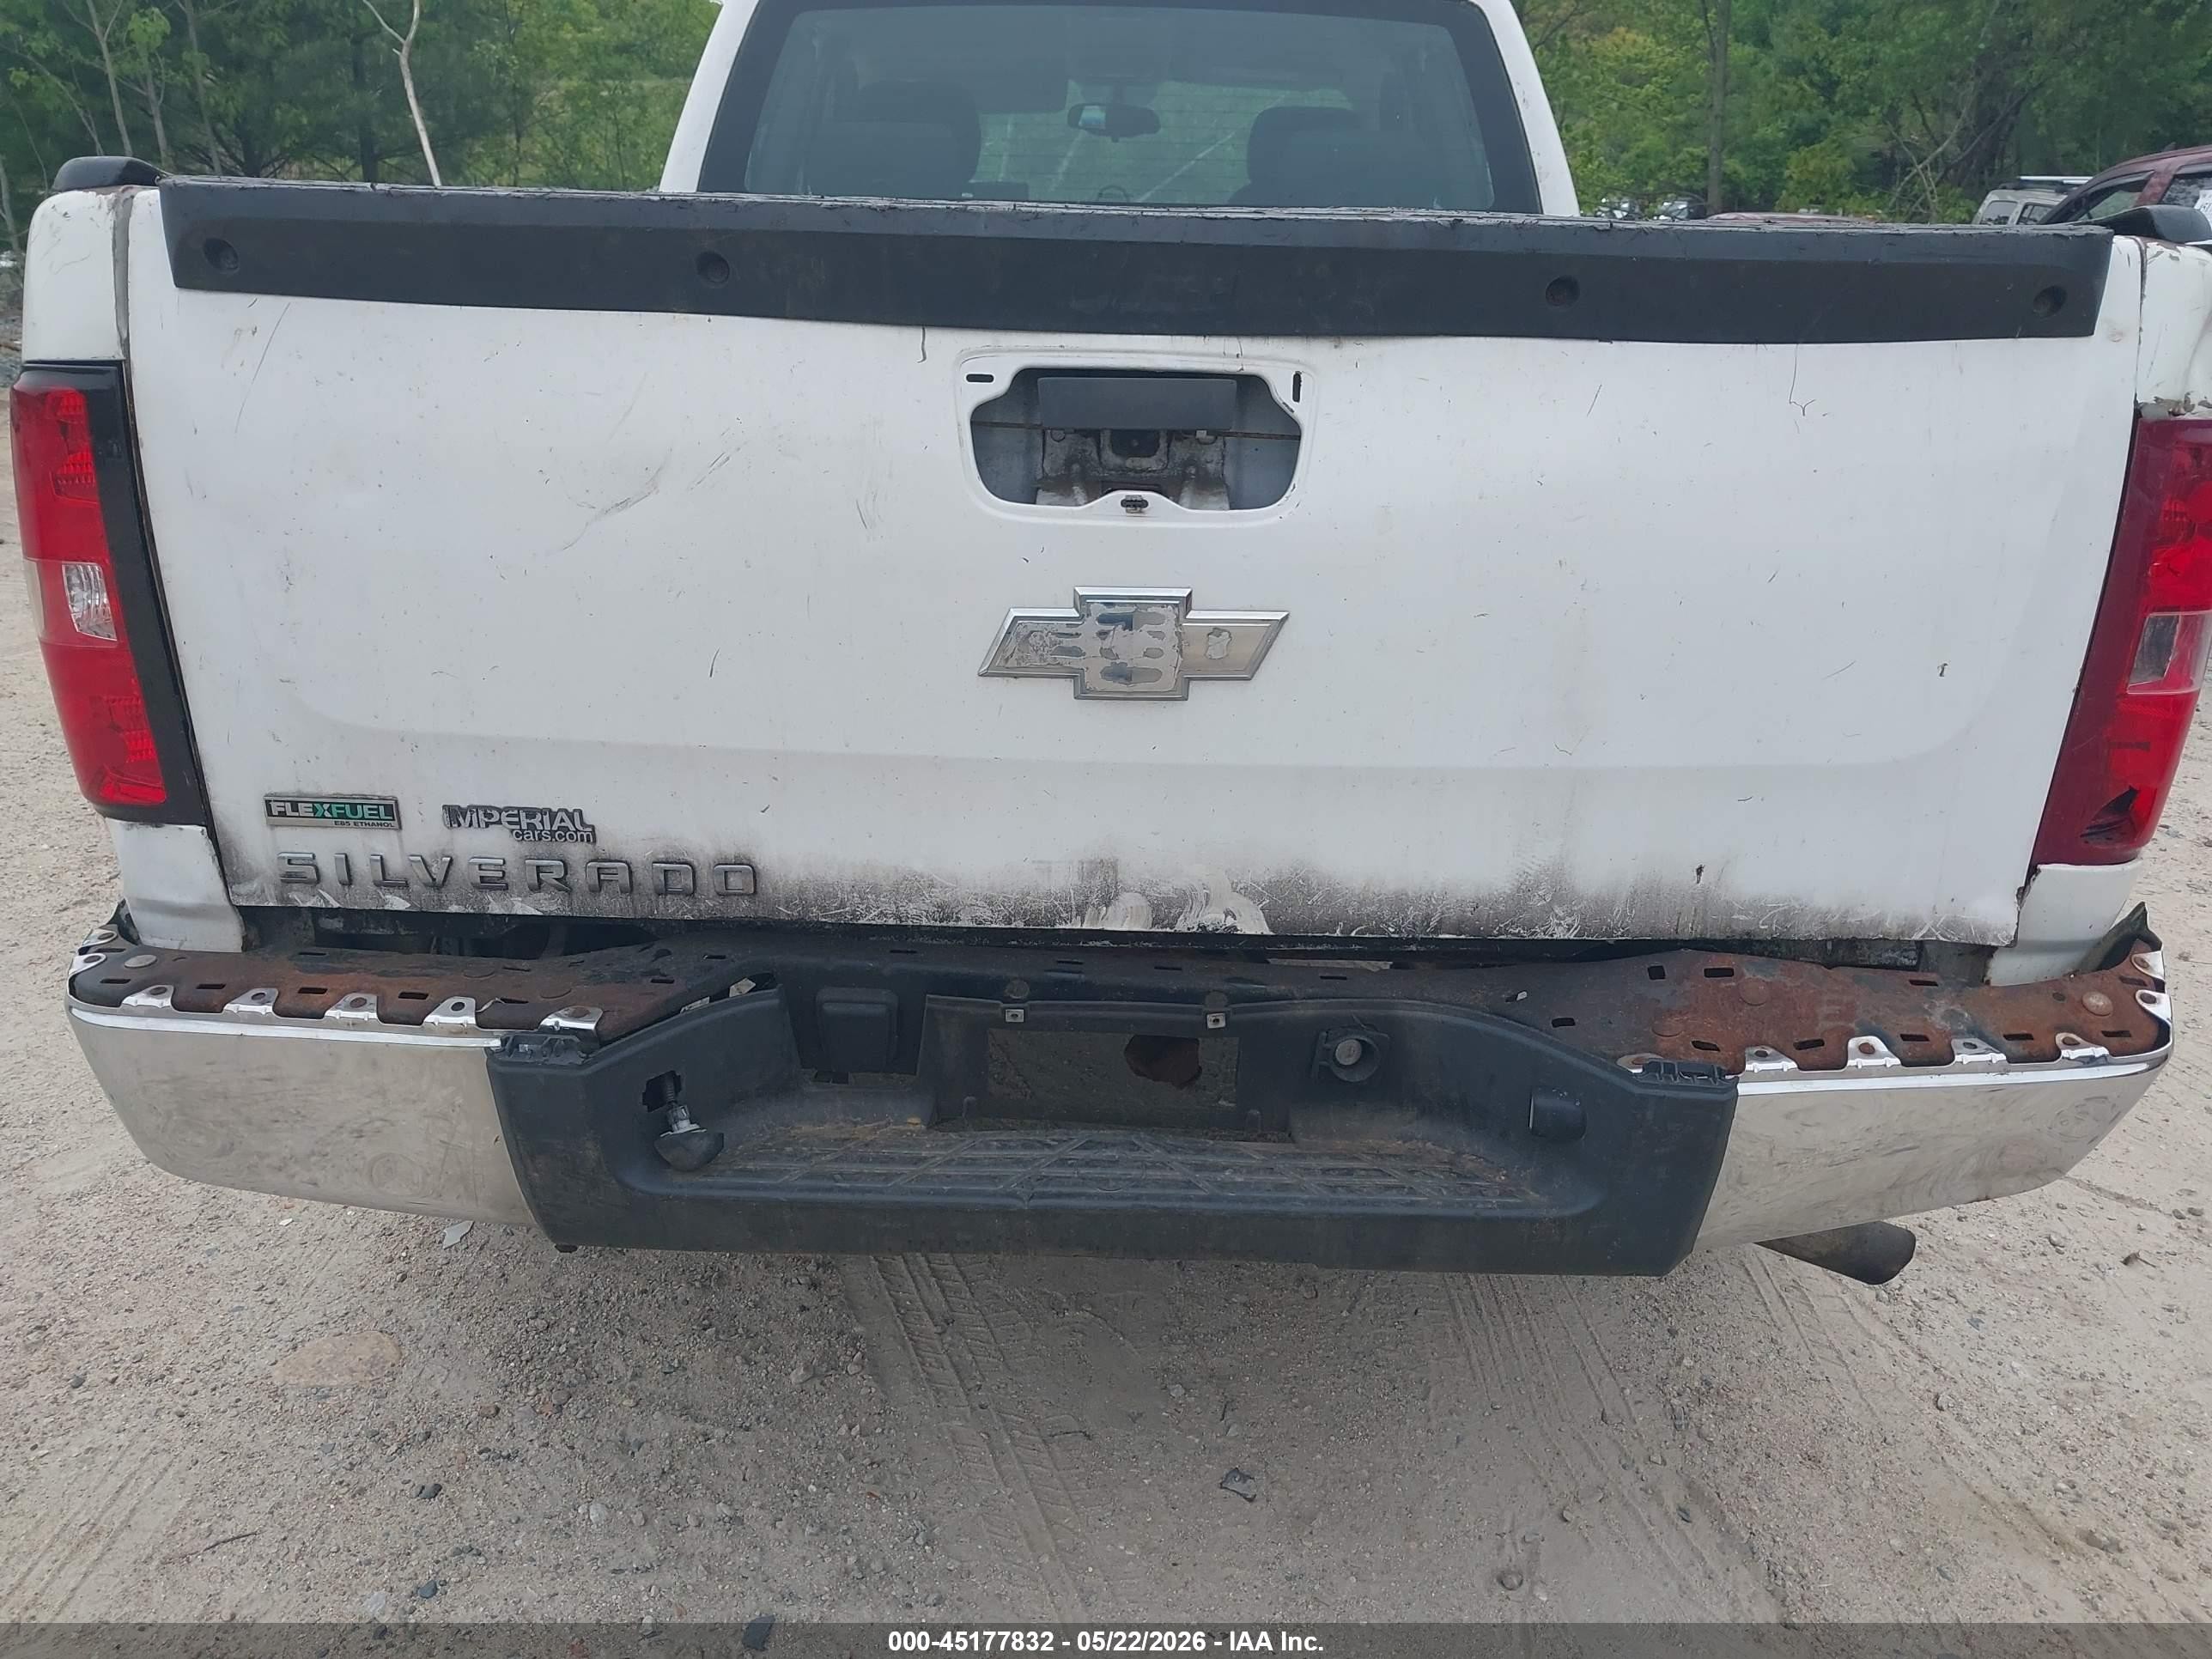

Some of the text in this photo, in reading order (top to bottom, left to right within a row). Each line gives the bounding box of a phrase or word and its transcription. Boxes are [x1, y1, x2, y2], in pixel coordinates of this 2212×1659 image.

[269, 801, 393, 820] FLEXFUEL
[442, 806, 592, 832] IMPERIAL
[512, 828, 594, 843] cars.com
[276, 852, 757, 896] SILVERADO
